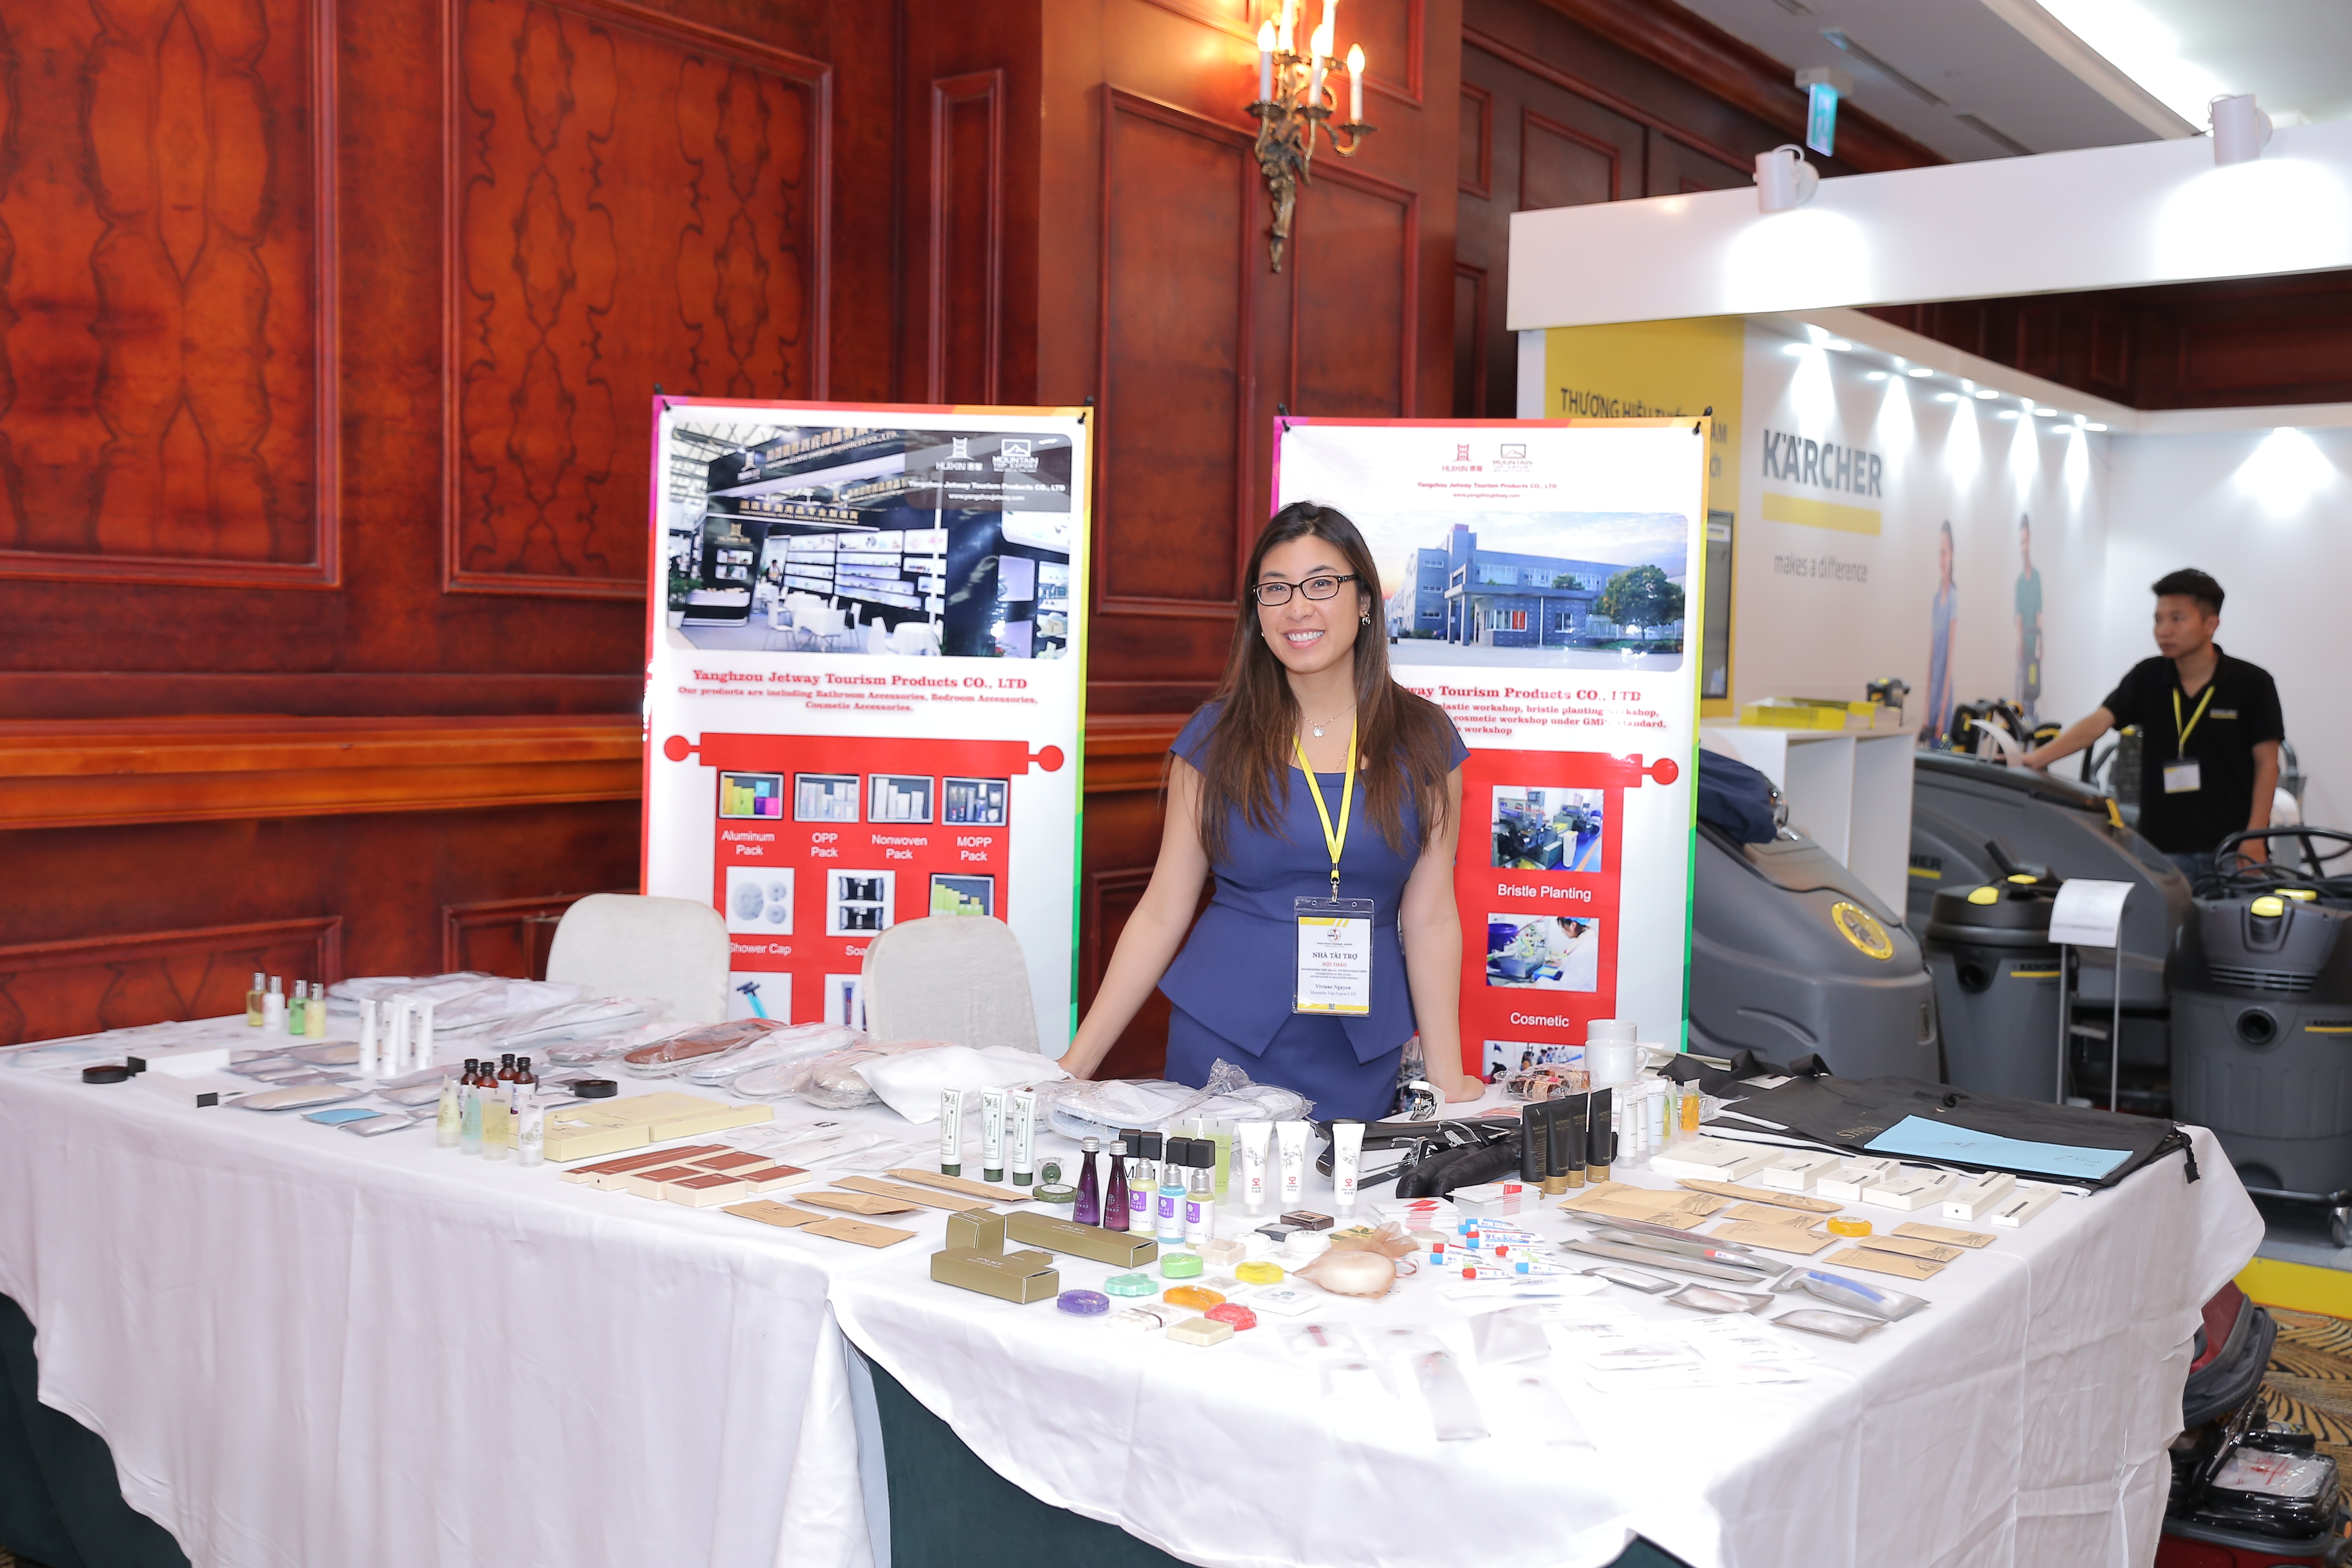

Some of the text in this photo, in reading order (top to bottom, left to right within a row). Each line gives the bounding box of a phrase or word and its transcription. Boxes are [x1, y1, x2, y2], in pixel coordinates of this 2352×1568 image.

[992, 456, 1039, 464] MOUNTAIN
[1763, 429, 1881, 498] KÄRCHER
[1773, 552, 1868, 582] makes a difference
[693, 670, 1027, 689] Yanghzou Jetway Tourism Products CO., LTD
[931, 693, 975, 702] Bedroom
[1439, 686, 1499, 698] Tourism
[1504, 687, 1571, 700] Products
[1576, 690, 1605, 701] CO.,
[805, 701, 850, 710] Cosmetic
[1473, 704, 1523, 713] workshop,
[1526, 705, 1559, 713] bristle
[1562, 707, 1604, 716] planting
[1500, 716, 1548, 726] workshop
[1551, 717, 1580, 726] under
[1464, 726, 1512, 735] workshop
[721, 830, 775, 842] Aluminum
[811, 832, 838, 844] OPP
[871, 834, 928, 846] Nonwoven
[956, 836, 993, 848] MOPP
[735, 845, 764, 856] Pack
[811, 847, 839, 858] Pack
[885, 848, 913, 860] Pack
[960, 851, 988, 862] Pack
[1497, 883, 1592, 902] Bristle Planting
[769, 943, 792, 956] Cap
[845, 946, 867, 956] Soa
[1510, 1012, 1570, 1028] Cosmetic
